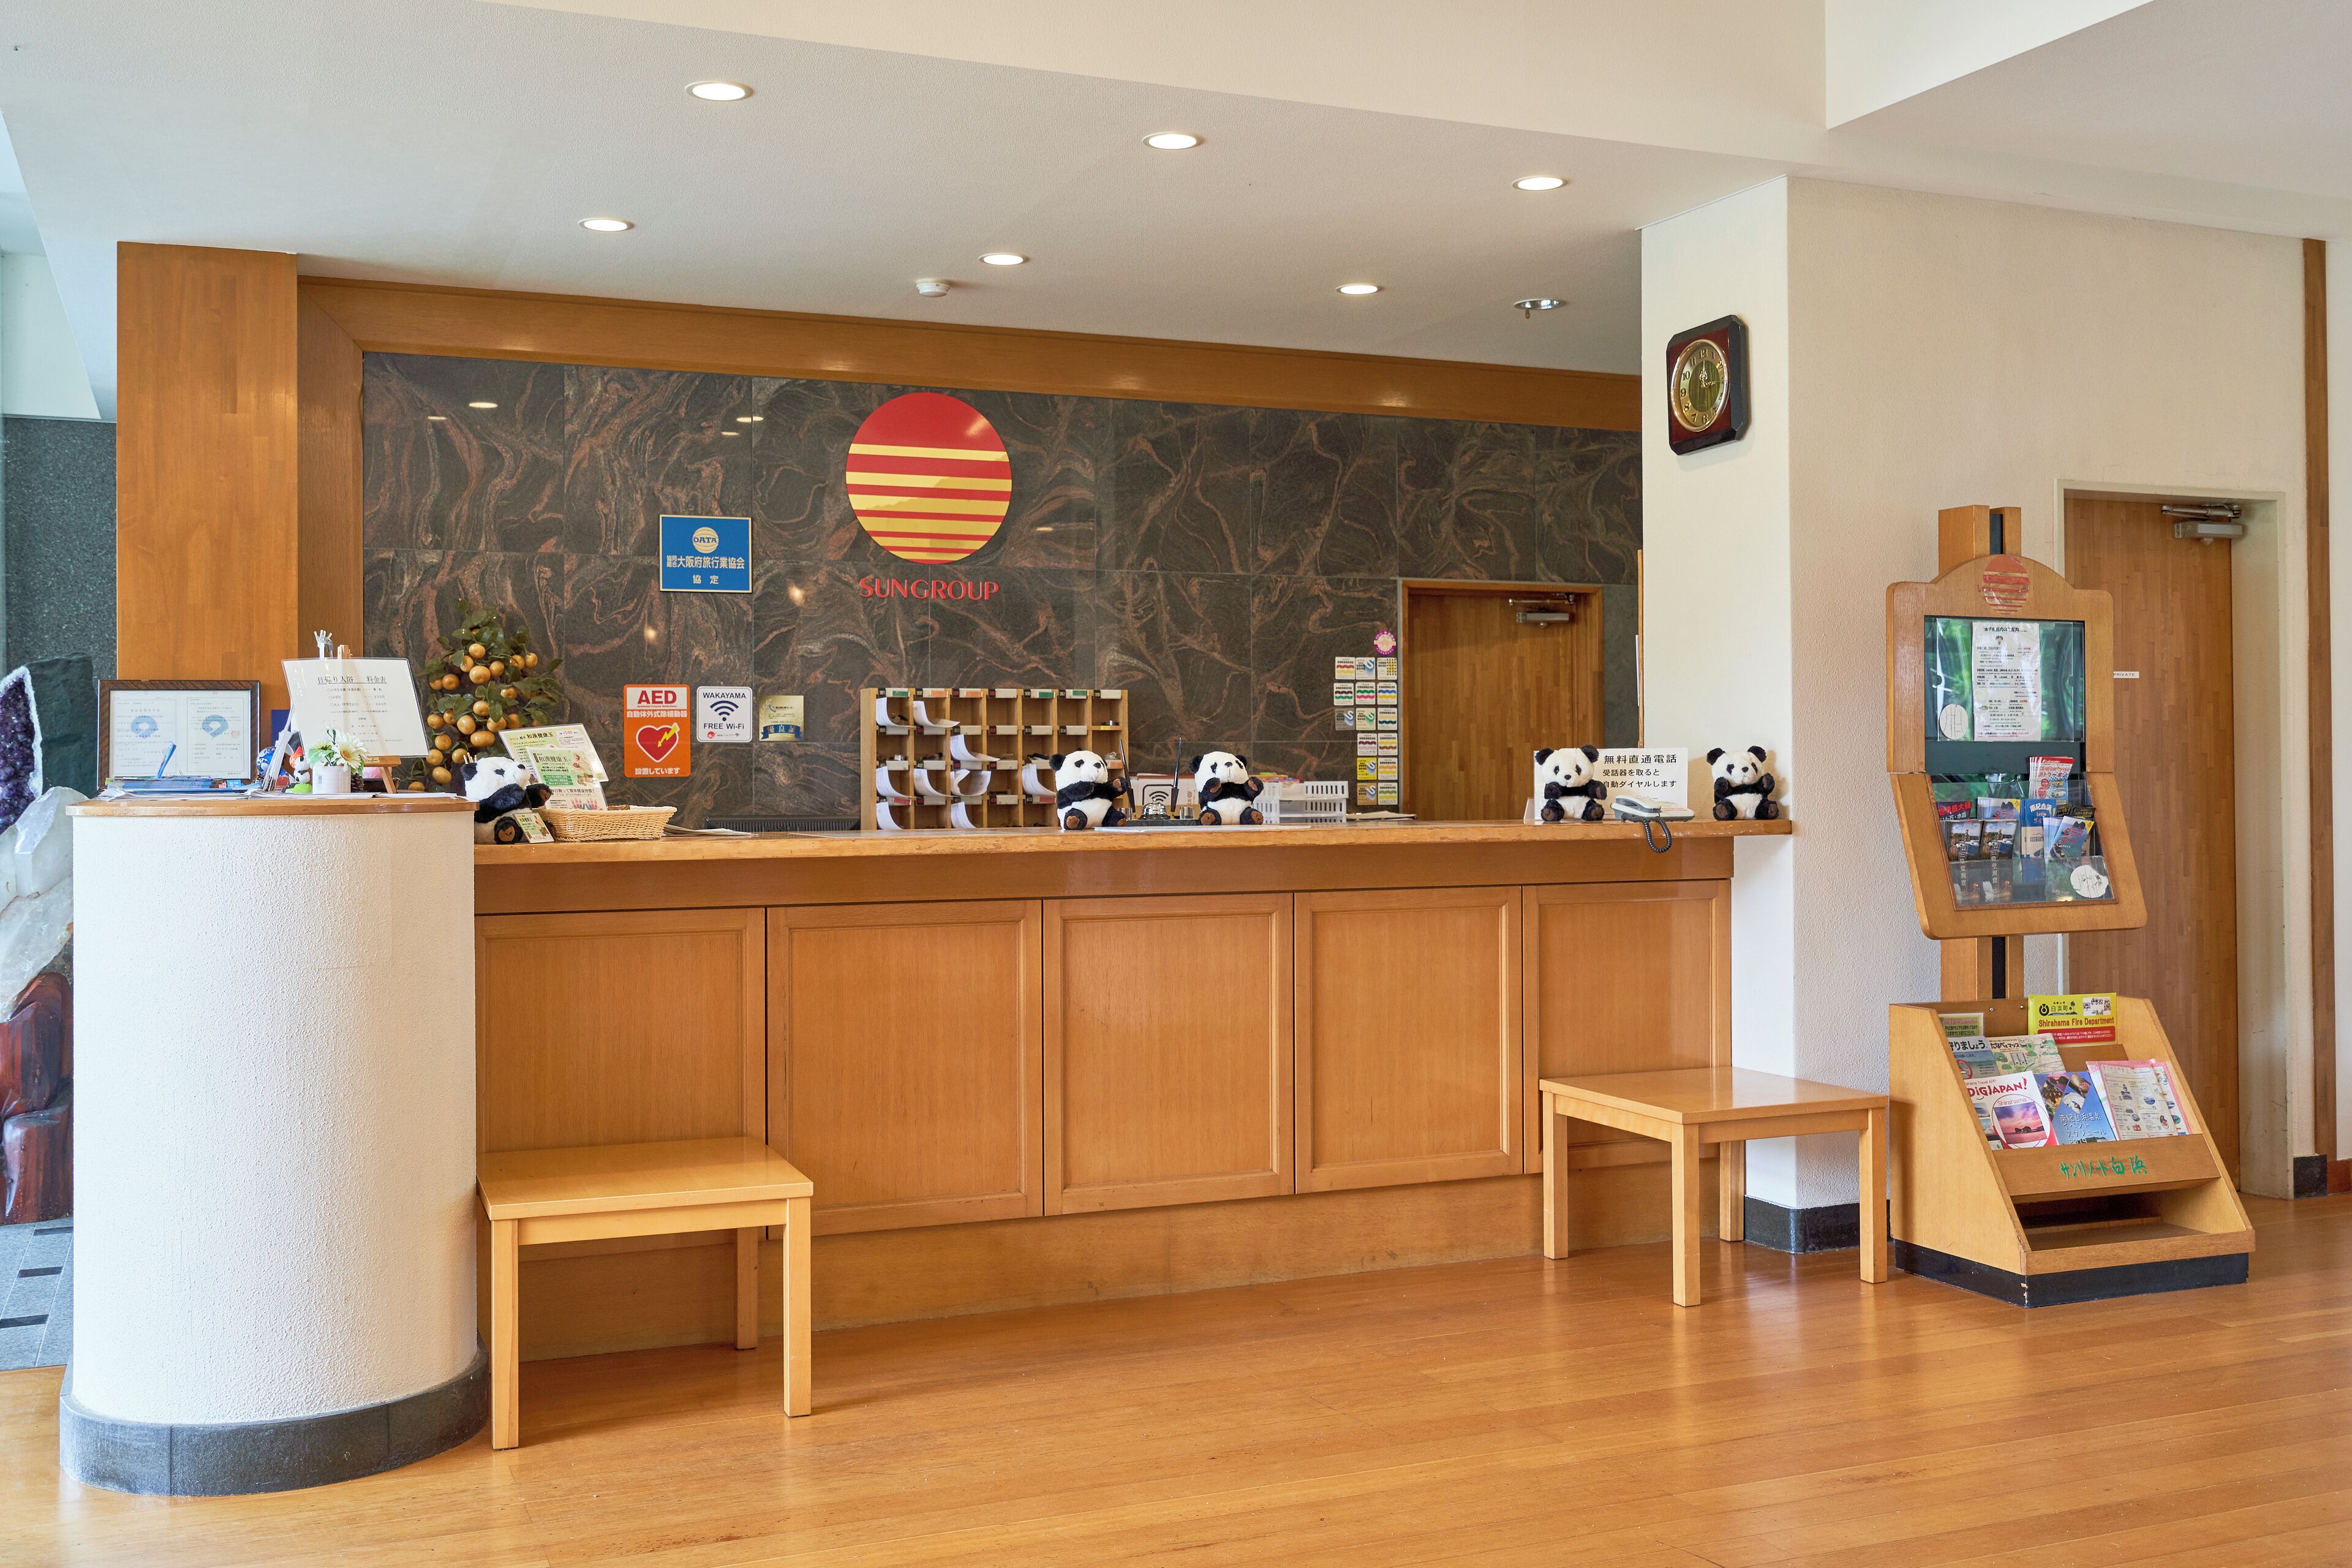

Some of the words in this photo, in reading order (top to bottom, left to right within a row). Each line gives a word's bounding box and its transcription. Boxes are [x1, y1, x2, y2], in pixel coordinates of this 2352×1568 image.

[1683, 371, 1691, 380] 10
[1681, 388, 1687, 397] 9
[1684, 403, 1691, 412] 8
[1691, 413, 1698, 423] 7
[859, 577, 1000, 601] SUNGROUP
[638, 690, 677, 704] AED
[1604, 755, 1677, 764] 無料直通電話
[2029, 803, 2052, 812] 南紀白浜
[2038, 1018, 2070, 1027] Shirahama
[2071, 1017, 2082, 1026] Fire
[2084, 1017, 2114, 1026] Department
[1997, 1097, 2027, 1106] Shirahama
[2059, 1112, 2102, 1123] 南紀白浜温泉
[2064, 1121, 2090, 1130] イベント
[2066, 1129, 2107, 1137] スケジュール
